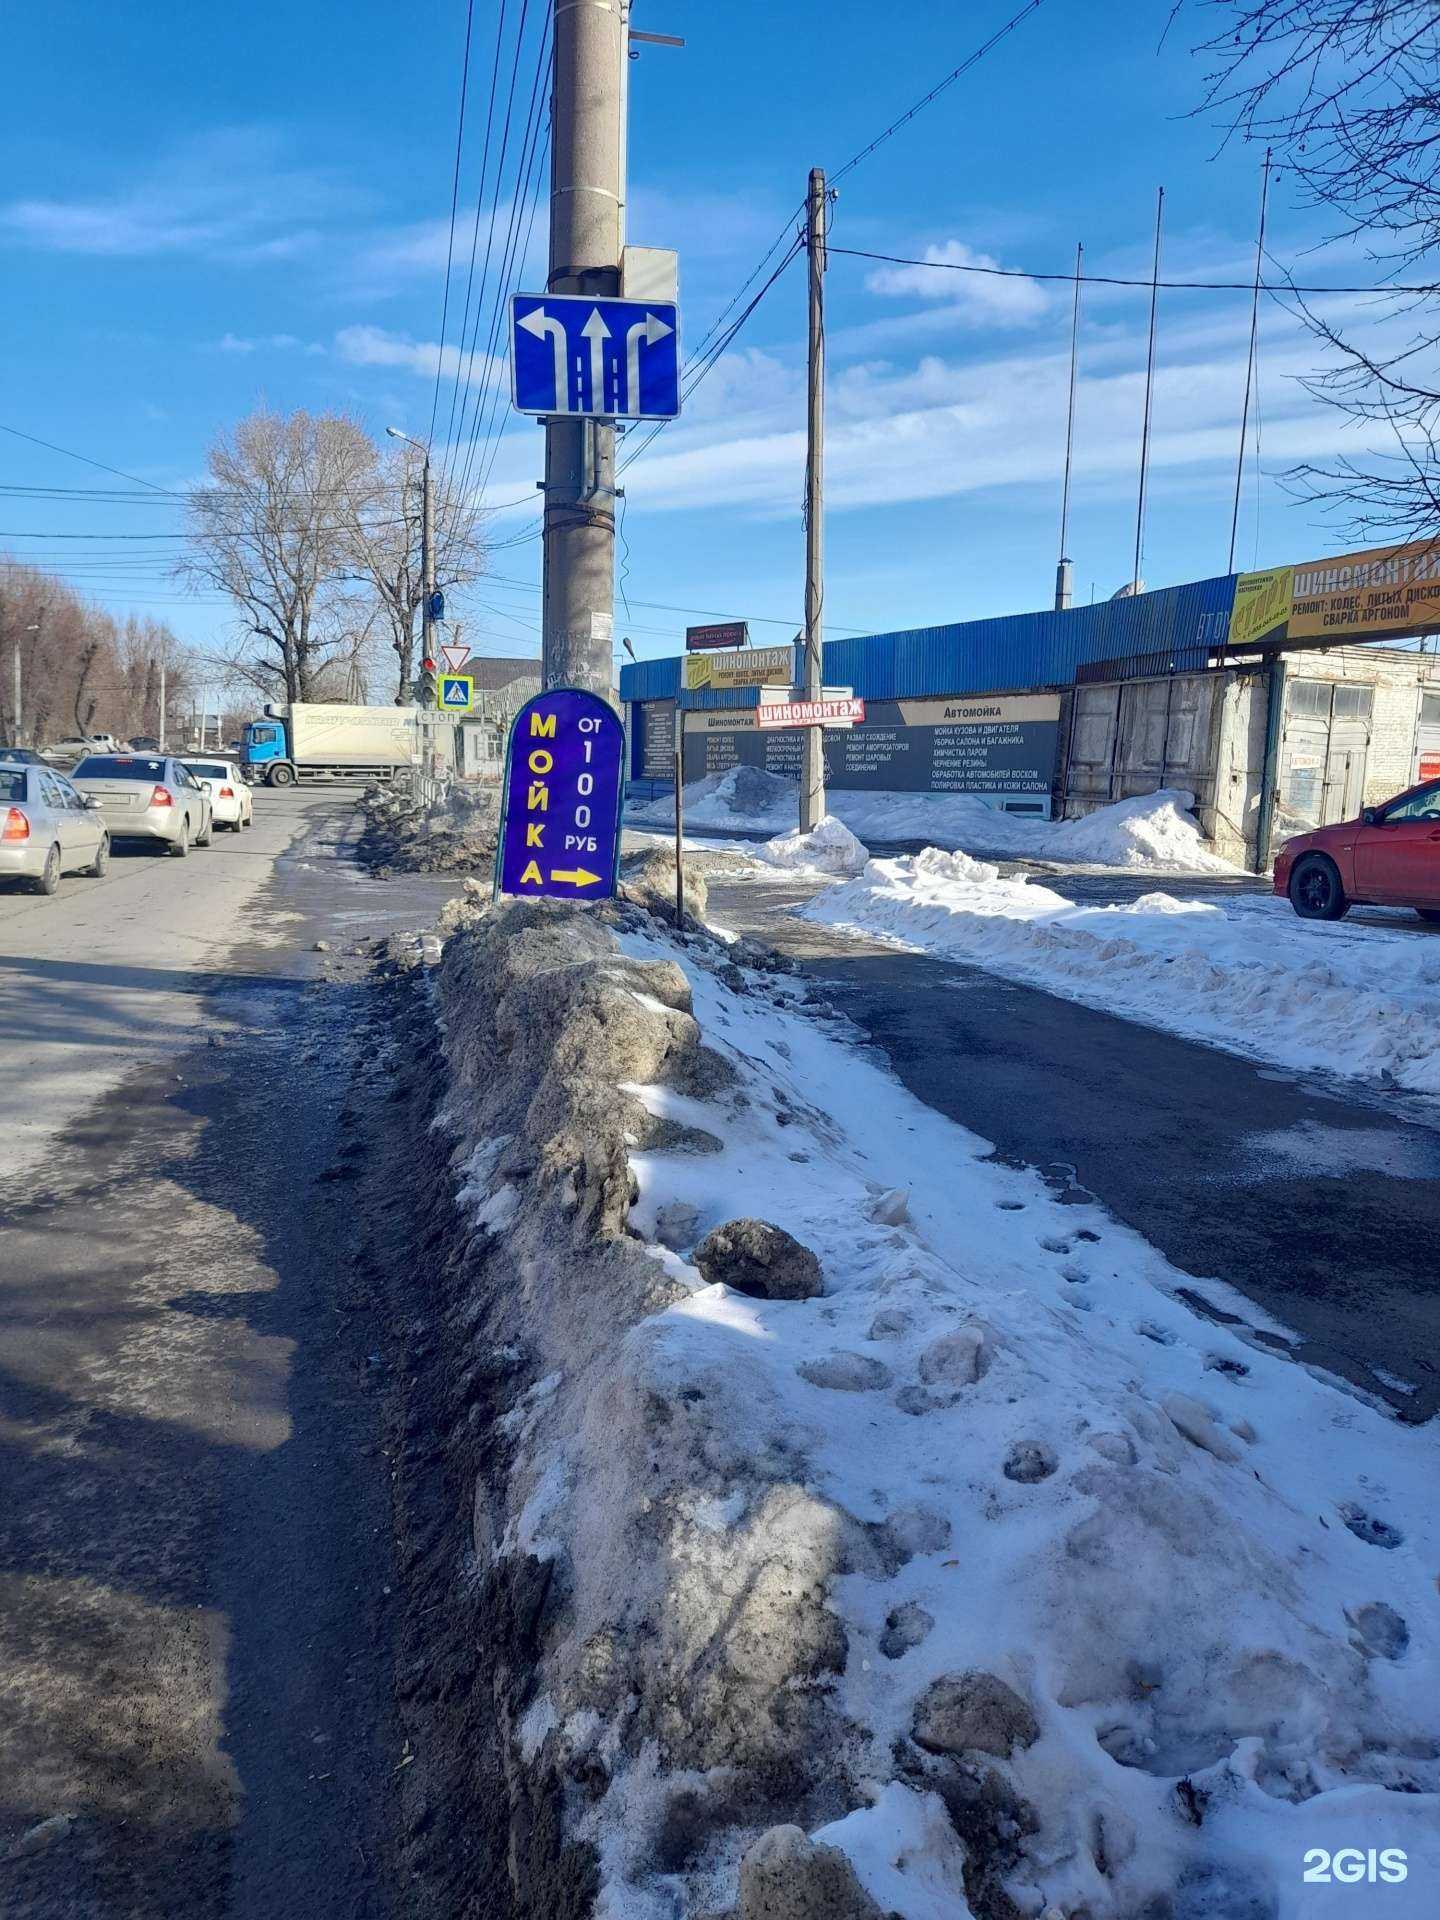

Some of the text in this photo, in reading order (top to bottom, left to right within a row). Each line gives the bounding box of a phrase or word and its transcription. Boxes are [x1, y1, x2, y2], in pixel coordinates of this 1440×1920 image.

[1291, 584, 1440, 616] РЕМОНТ: КОЛЕС, ЛИТЫХ ДИСКО
[1322, 604, 1410, 627] СВАРКА АРГОНОМ
[421, 712, 455, 722] СТОП
[578, 717, 602, 734] ОТ
[954, 726, 977, 735] КУЗОВА
[983, 724, 1019, 735] ДВИГАТЕЛЯ
[933, 738, 955, 746] УБОРКА
[956, 737, 980, 746] САЛОНА
[987, 736, 1024, 745] БАГАЖНИКА
[846, 743, 910, 752] РЕМОНТ АМОРТИЗАТОРОВ
[933, 748, 966, 757] ХИМЧИСТКА
[845, 753, 864, 762] РЕМОНТ
[931, 769, 1038, 779] ОБРАБОТКА АВТОМОБИЛЕЙ ВОСКОМ
[931, 781, 965, 790] ПОЛИРОВКА
[966, 781, 996, 790] ПЛАСТИКА
[1003, 781, 1020, 790] КОЖИ
[1021, 781, 1048, 791] САЛОНА
[519, 712, 557, 885] МОЙКА
[564, 835, 598, 851] РУБ
